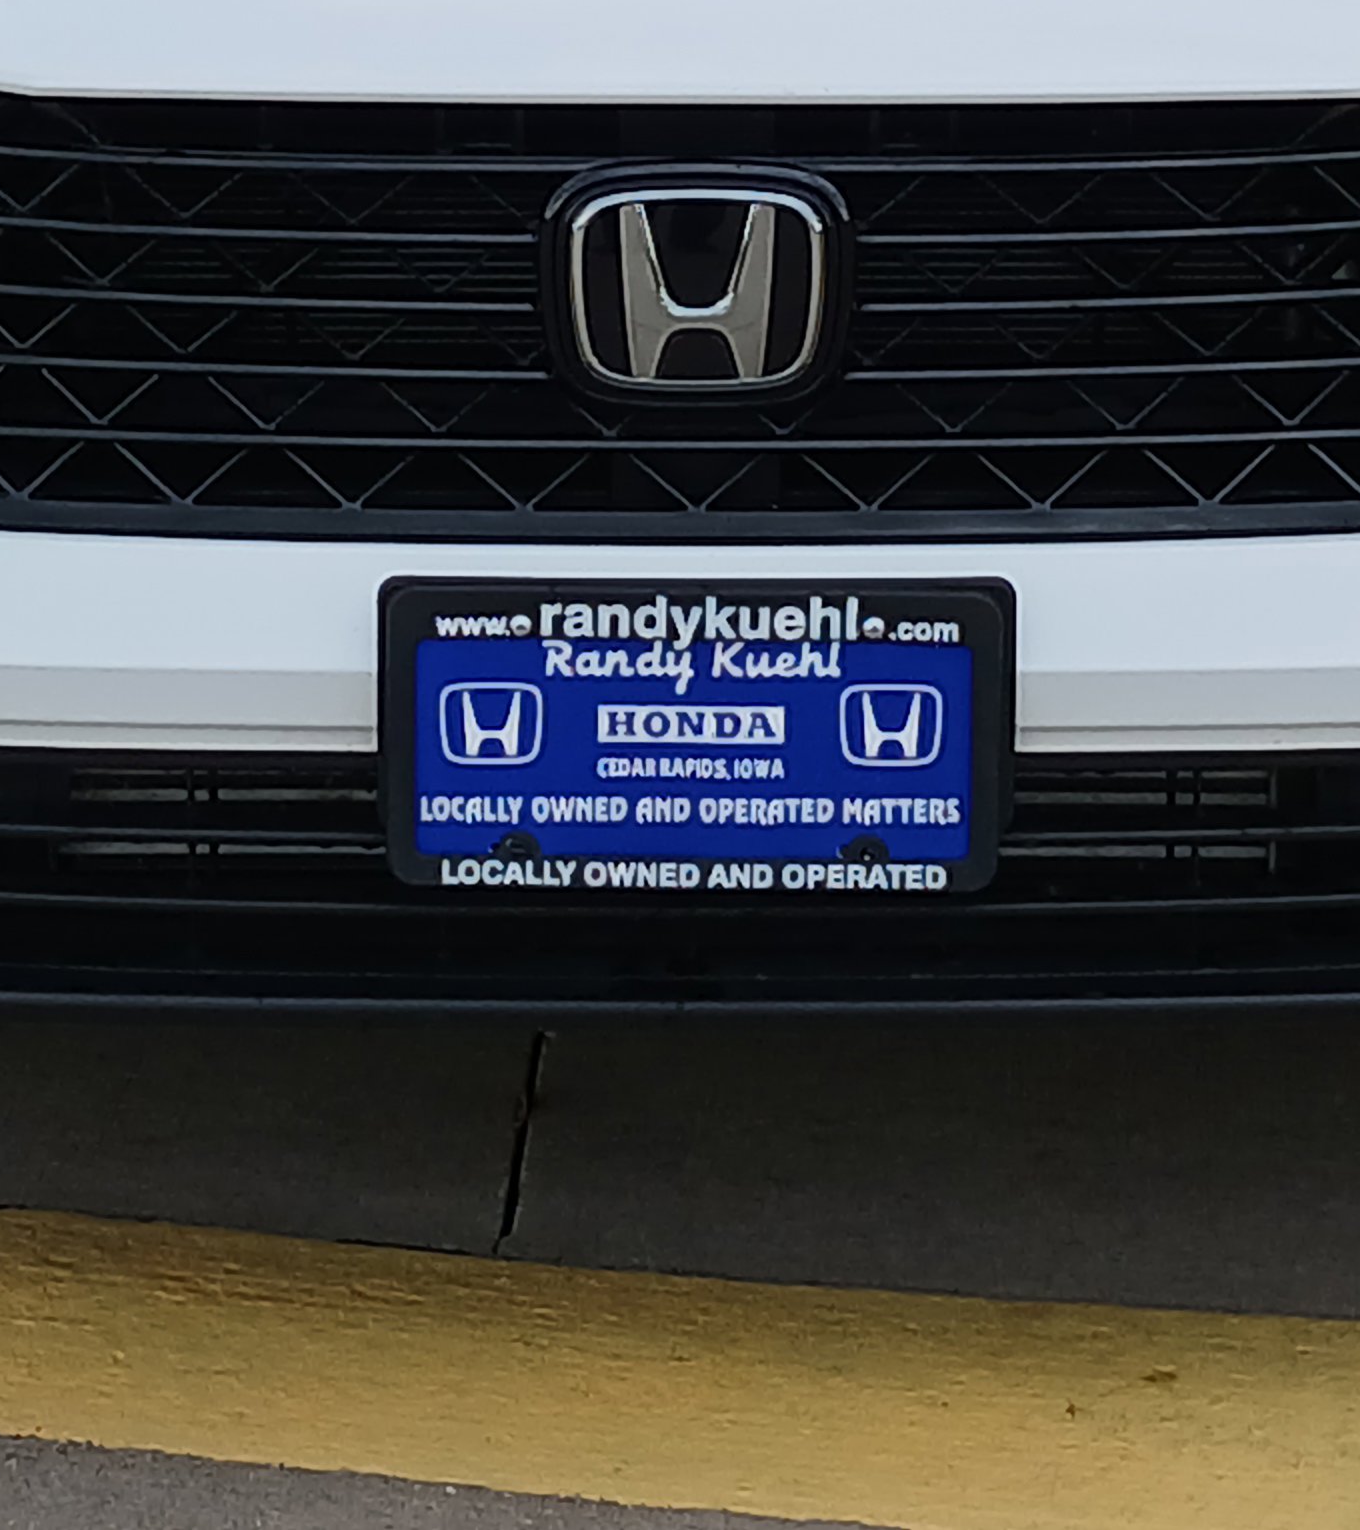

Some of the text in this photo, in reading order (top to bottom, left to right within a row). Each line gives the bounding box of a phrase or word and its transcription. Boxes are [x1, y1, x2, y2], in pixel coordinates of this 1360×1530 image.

[539, 594, 859, 651] randykuehl
[541, 639, 841, 696] Randy Kuehl
[606, 711, 777, 739] HONDA
[733, 758, 785, 779] IOWA
[420, 796, 961, 826] LOCALLY OWNED AND OPERATED MATTERS
[441, 858, 947, 890] LOCALLY OWNED AND OPERATED
